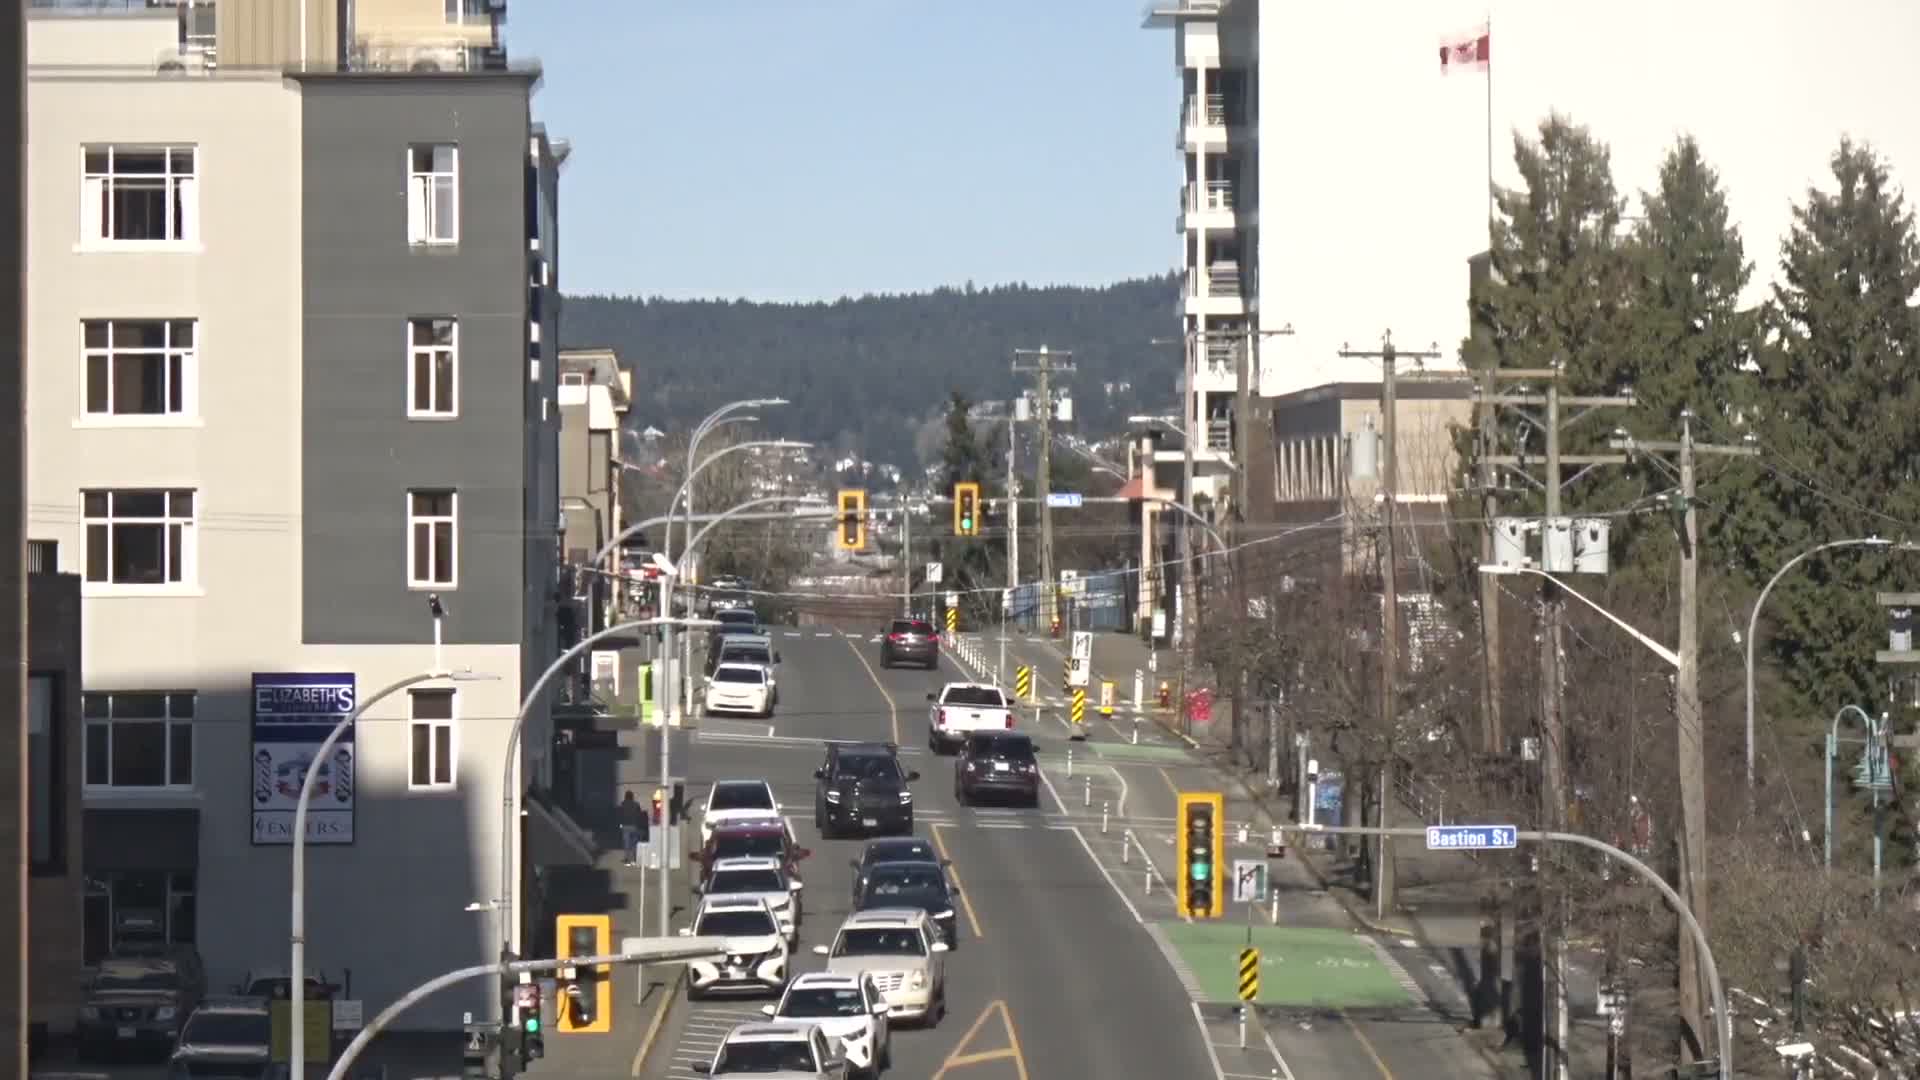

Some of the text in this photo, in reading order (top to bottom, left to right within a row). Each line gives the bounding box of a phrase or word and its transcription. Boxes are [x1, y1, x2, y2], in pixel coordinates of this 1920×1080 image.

[268, 822, 340, 834] EMERS
[1430, 829, 1513, 846] Bastion St.
